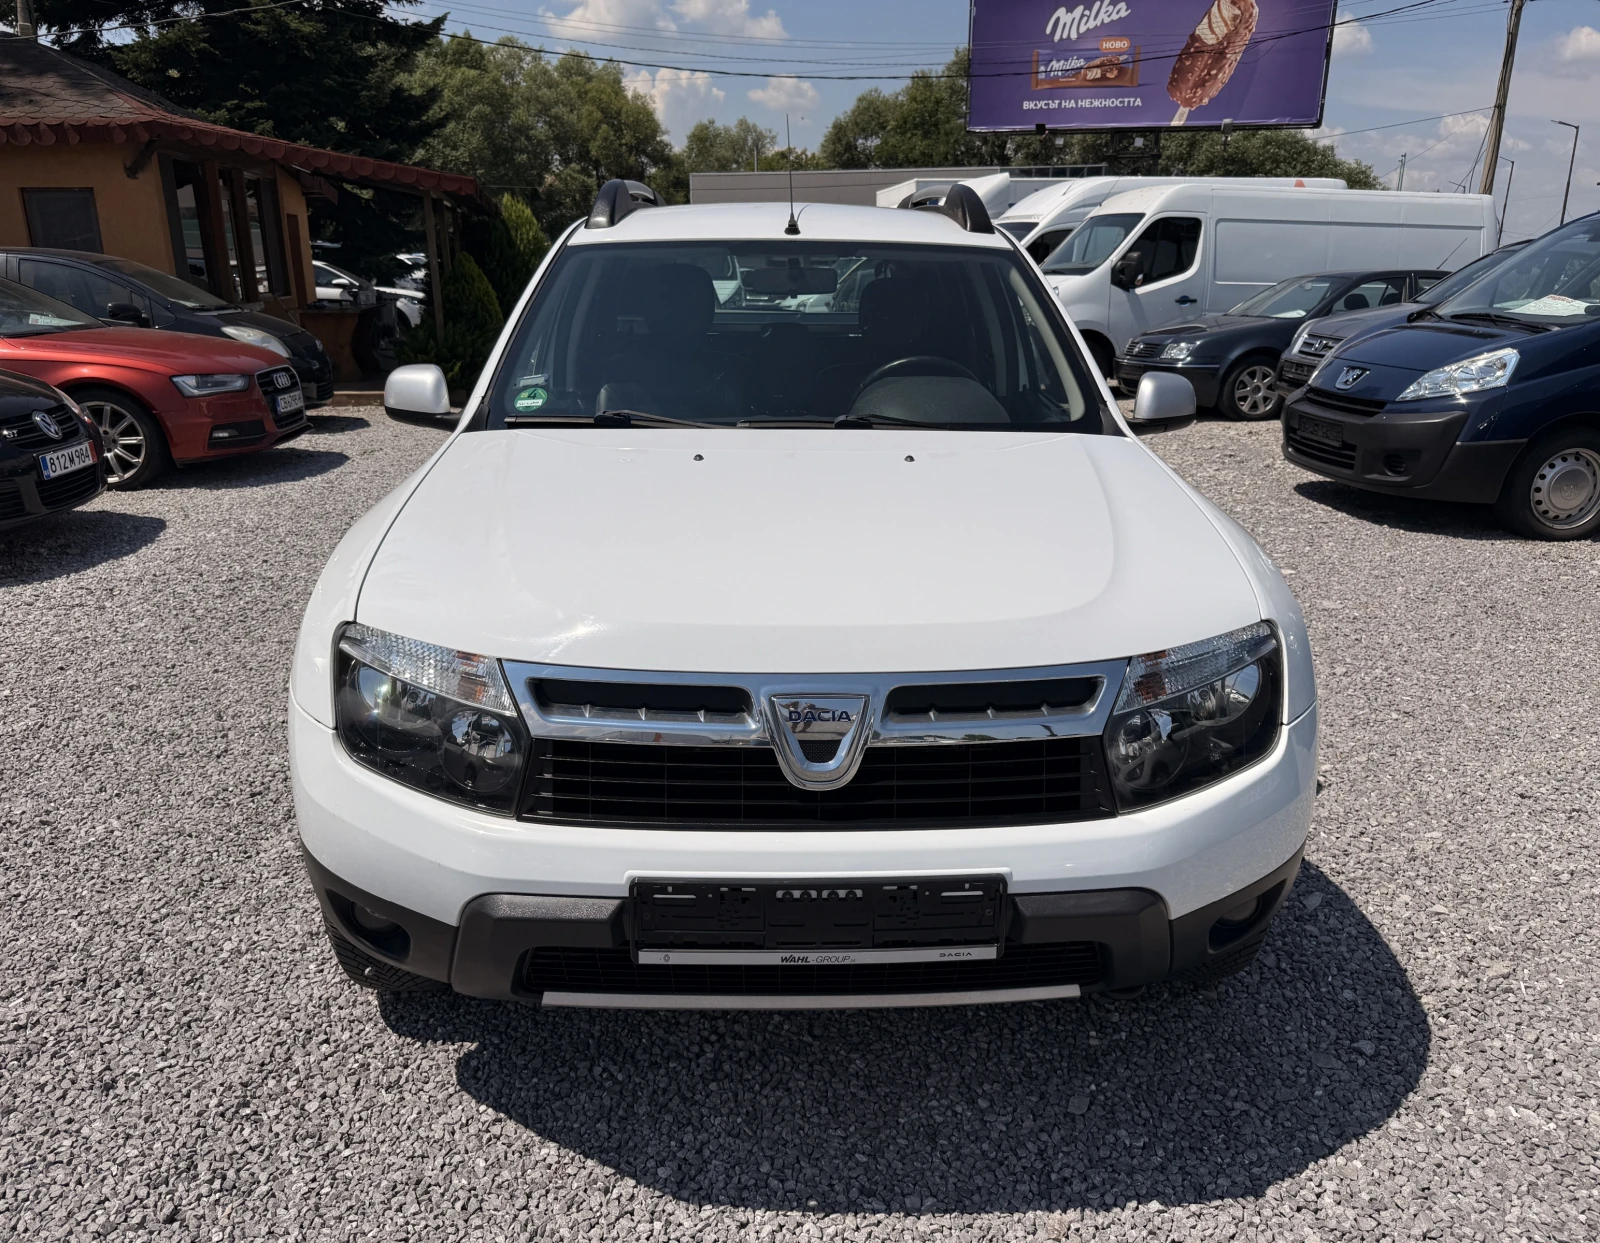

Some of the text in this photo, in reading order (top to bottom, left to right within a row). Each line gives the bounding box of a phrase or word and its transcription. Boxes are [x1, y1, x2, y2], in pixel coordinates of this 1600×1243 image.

[1045, 0, 1132, 43] Milka
[1102, 41, 1128, 50] НОВО
[1047, 55, 1086, 77] Milka
[1022, 97, 1142, 110] ВКУСЪТ НА НЕЖНОСТТА
[527, 388, 537, 399] 4
[788, 710, 852, 722] DACIA
